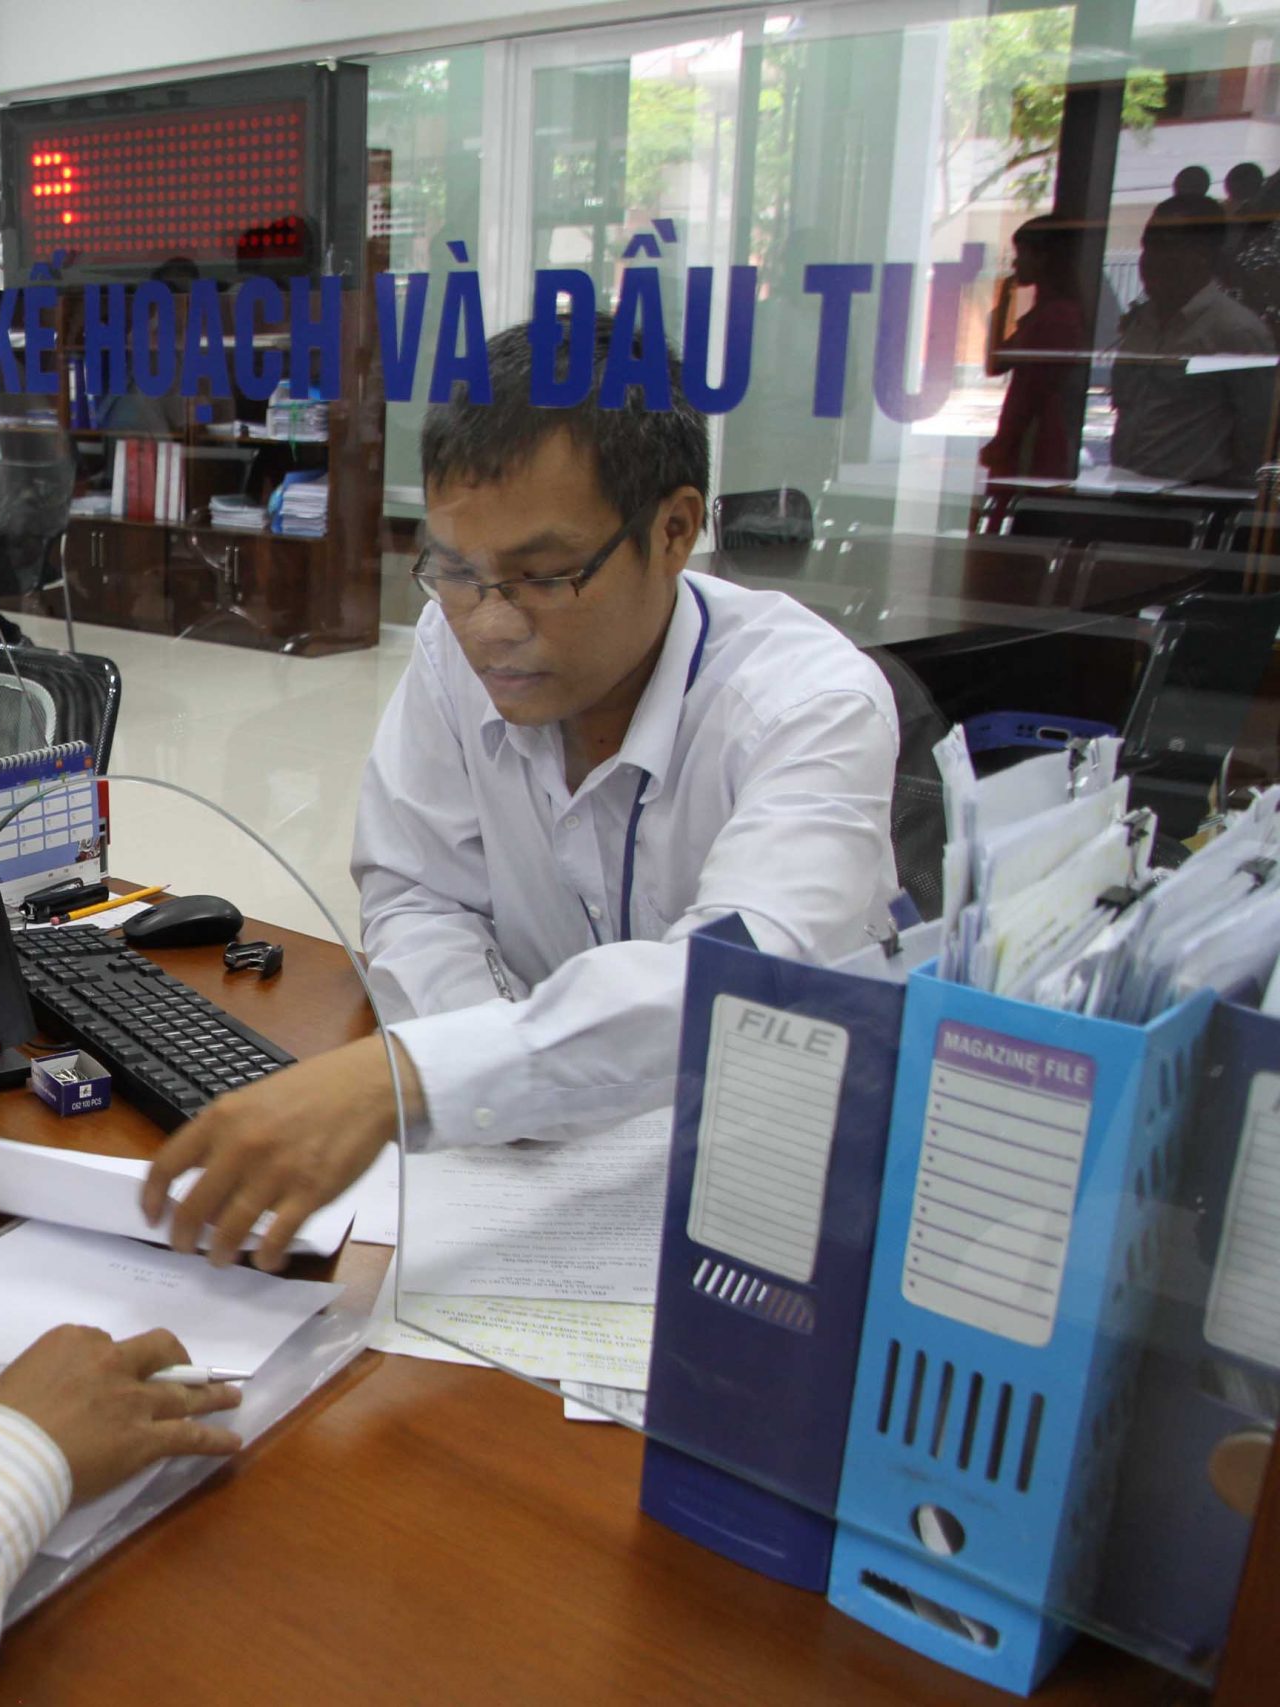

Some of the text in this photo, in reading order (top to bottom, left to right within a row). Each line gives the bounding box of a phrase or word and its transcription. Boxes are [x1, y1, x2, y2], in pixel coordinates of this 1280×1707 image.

[85, 277, 342, 423] HOẠCH
[375, 241, 492, 404] VÀ
[528, 218, 757, 415] ĐẦU
[803, 242, 985, 423] TƯ
[738, 1008, 836, 1057] FILE
[943, 1031, 1088, 1086] MAGAZINE FILE
[91, 1097, 102, 1106] PCS
